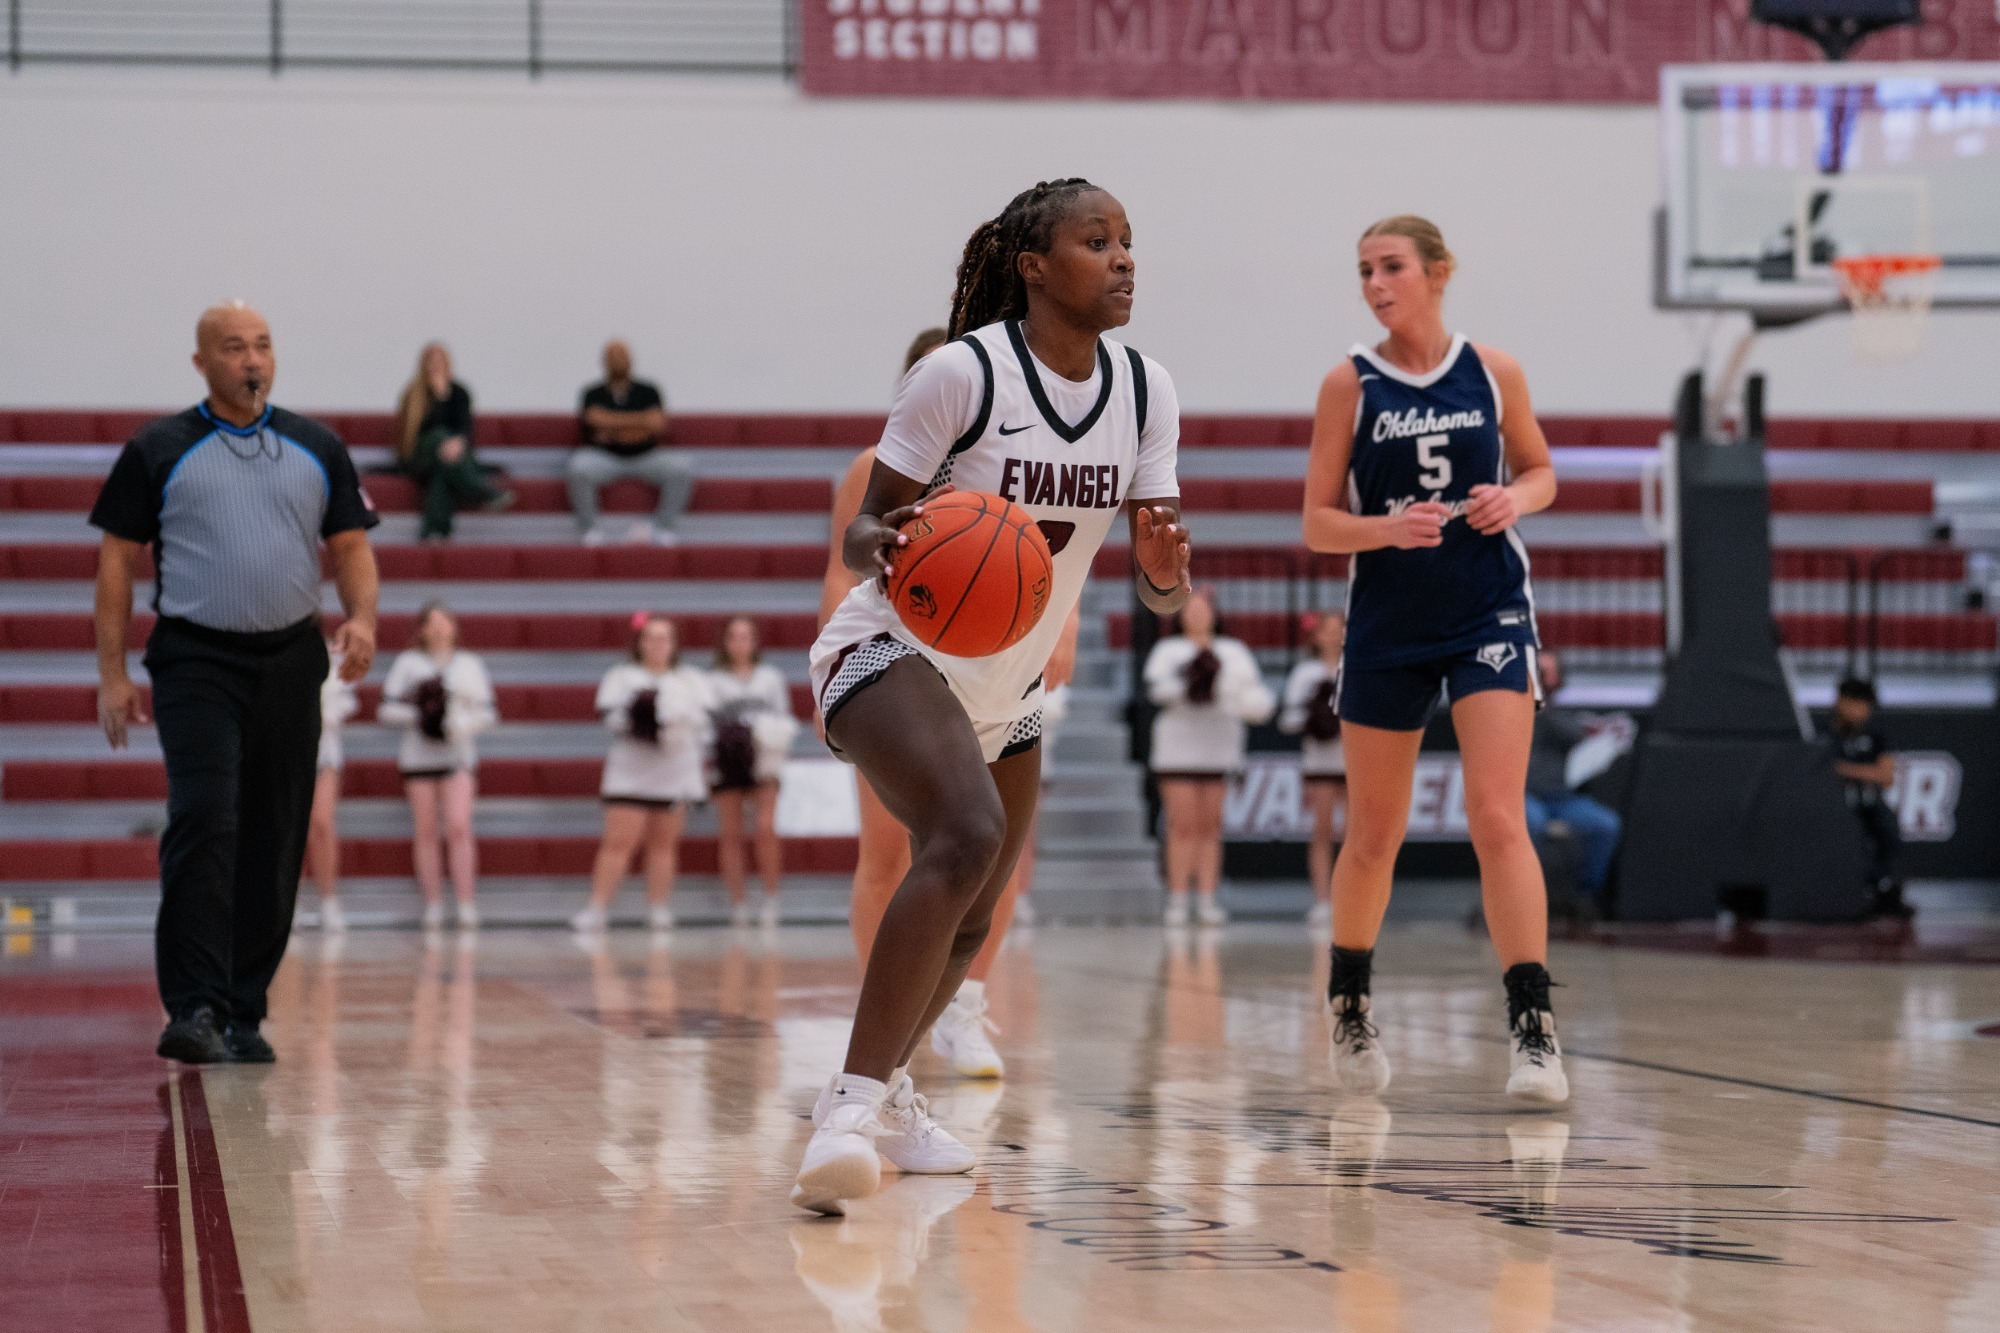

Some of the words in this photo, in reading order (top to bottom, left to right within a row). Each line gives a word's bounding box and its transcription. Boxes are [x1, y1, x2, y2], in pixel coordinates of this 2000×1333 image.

[833, 18, 1039, 61] SECTION
[1372, 406, 1485, 443] Oklahoma
[1000, 457, 1120, 509] EVANGEL
[1416, 434, 1452, 490] 5
